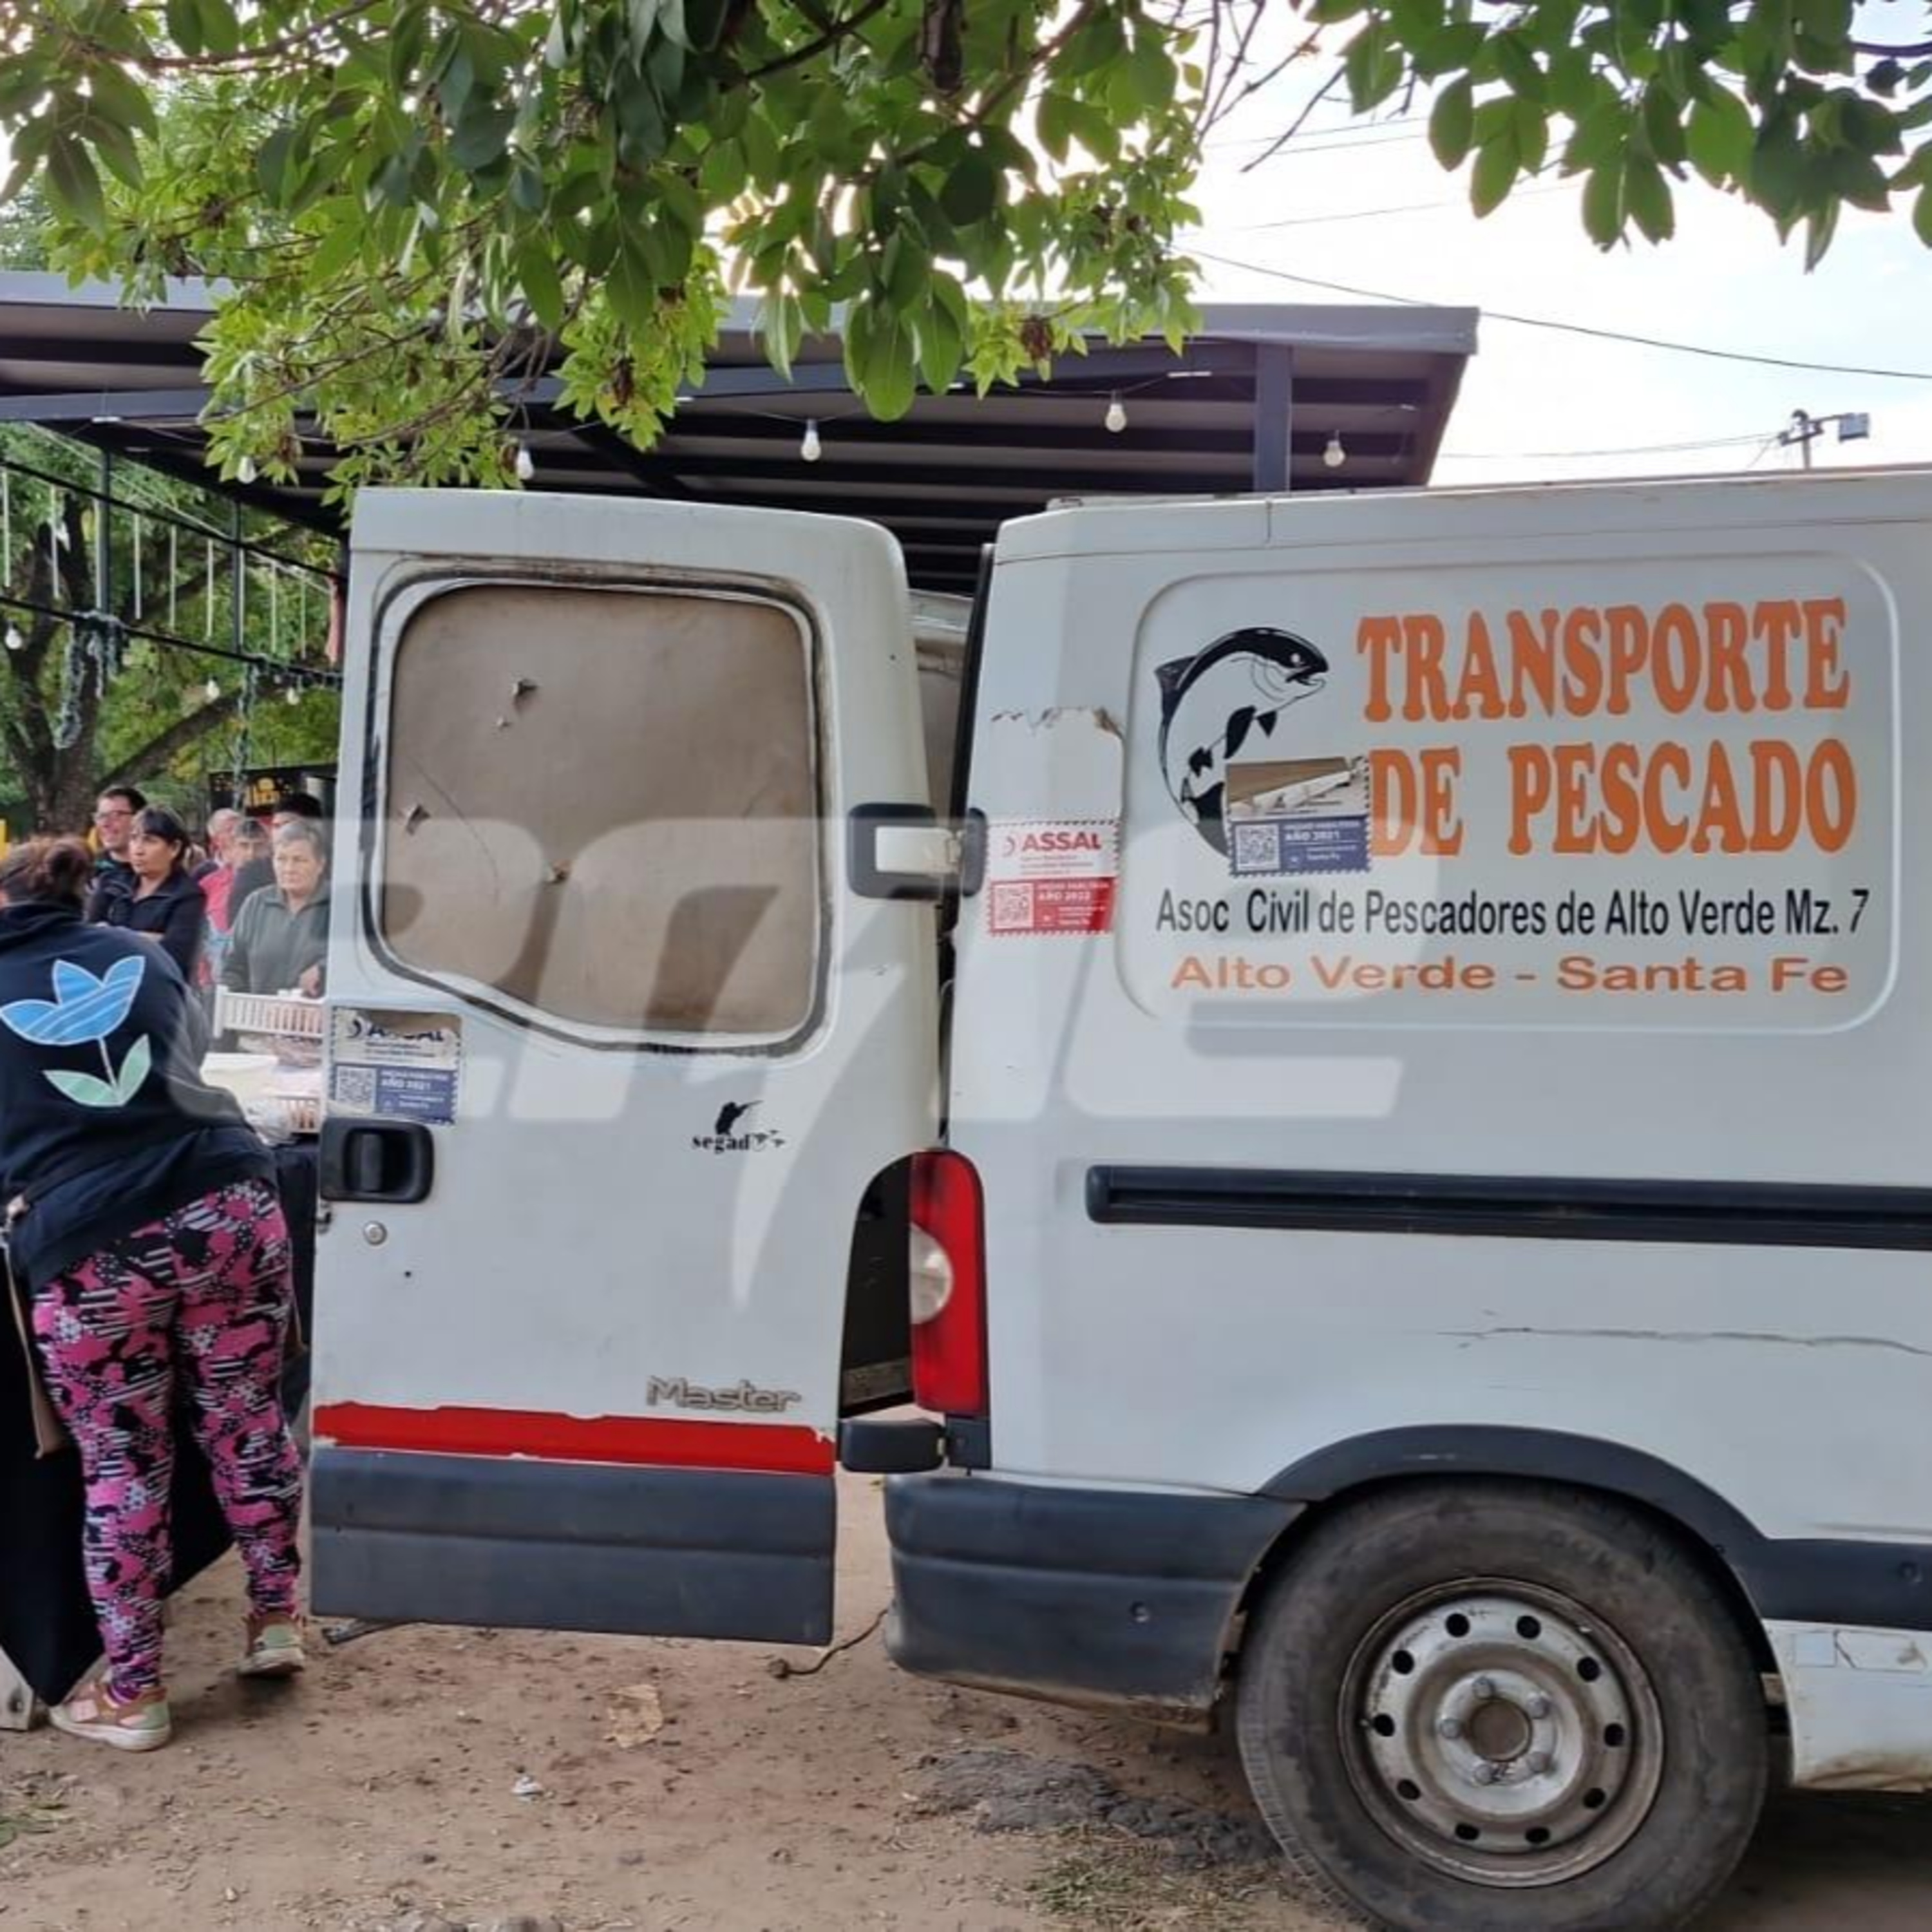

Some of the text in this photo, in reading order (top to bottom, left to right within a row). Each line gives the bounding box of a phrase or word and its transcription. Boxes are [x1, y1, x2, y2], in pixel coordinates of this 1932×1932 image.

[1356, 598, 1851, 724] TRANSPORTE
[1368, 738, 1860, 860] DE PESCADO
[1022, 831, 1102, 851] ASSAL
[1157, 888, 1870, 936] Asoc Civil de Pescadores de Alto Verde Mz. 7
[1171, 956, 1289, 989] Alto
[1311, 956, 1495, 990] Verde
[1557, 956, 1750, 995] Santa
[1770, 957, 1848, 992] Fe
[646, 1375, 802, 1413] Master
